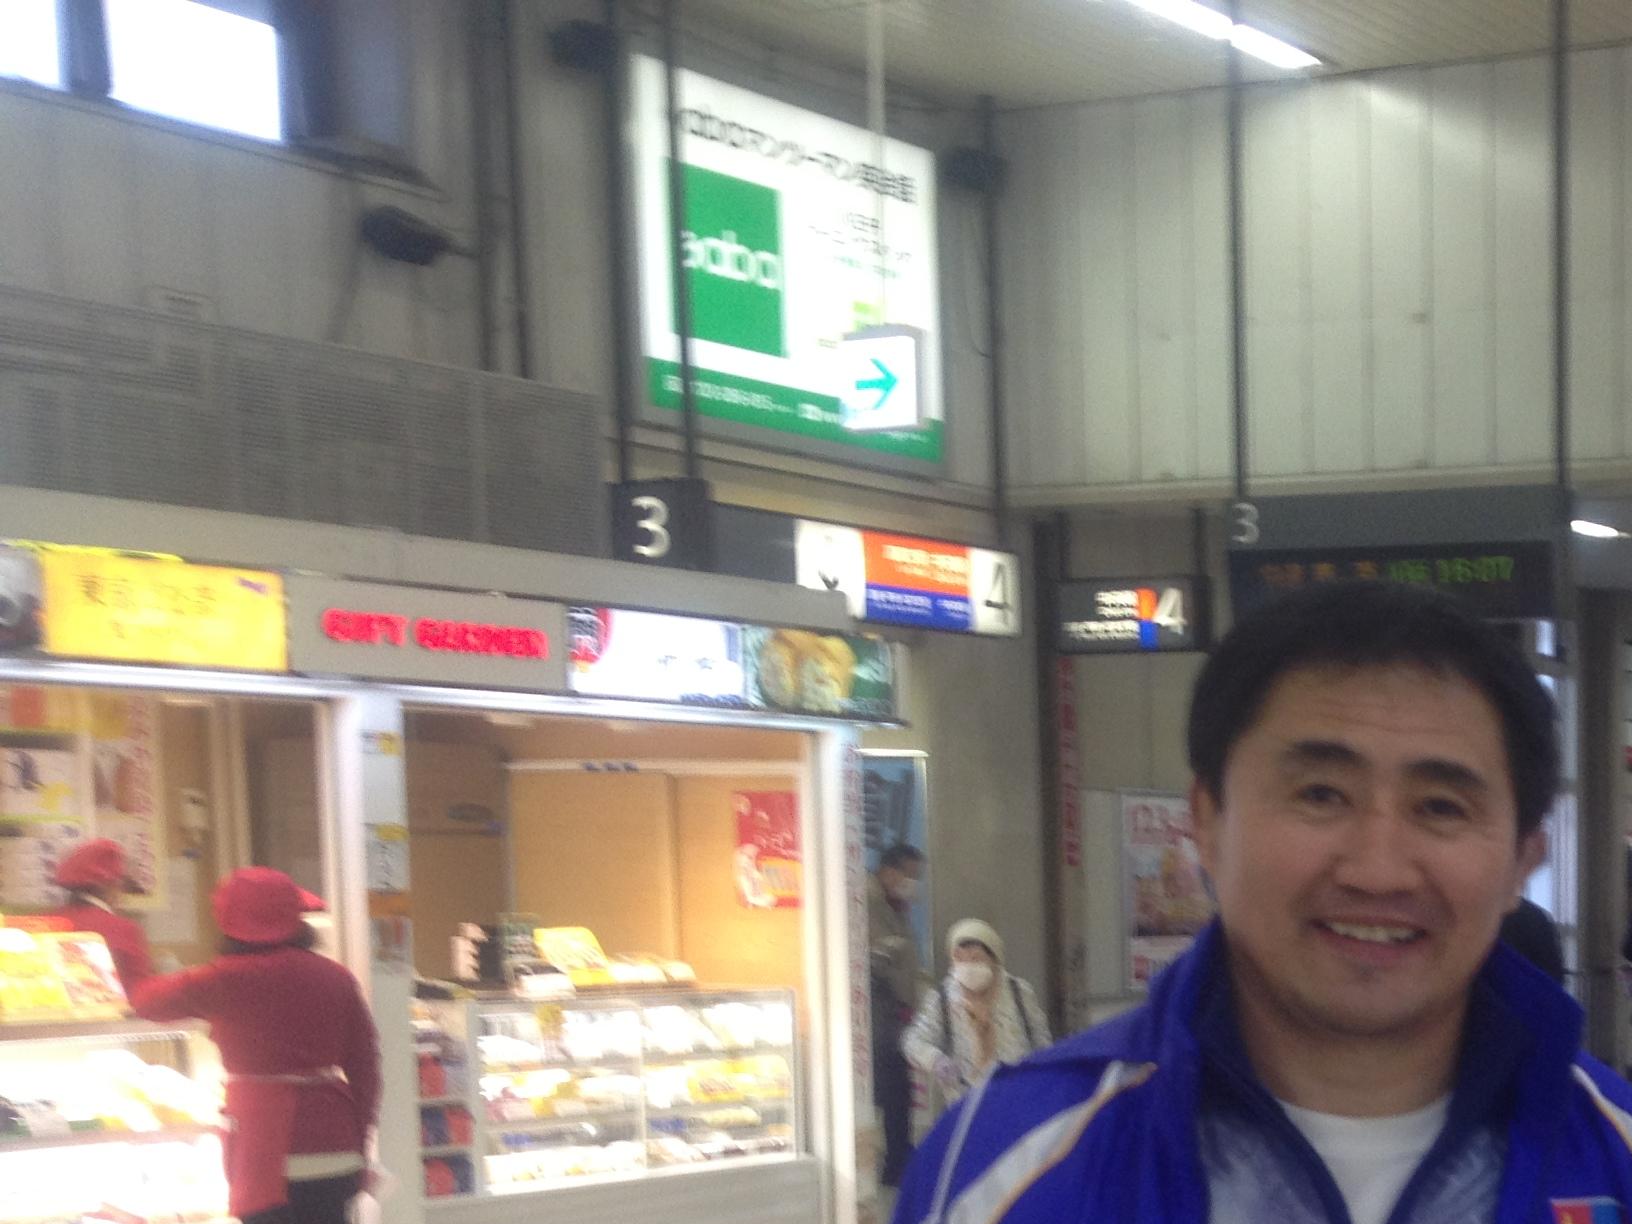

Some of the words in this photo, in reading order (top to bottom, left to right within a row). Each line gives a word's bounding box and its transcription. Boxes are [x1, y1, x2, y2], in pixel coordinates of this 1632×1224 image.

[631, 495, 671, 558] 3
[1231, 502, 1261, 545] 3
[984, 560, 1012, 628] 4
[1152, 587, 1188, 634] 4
